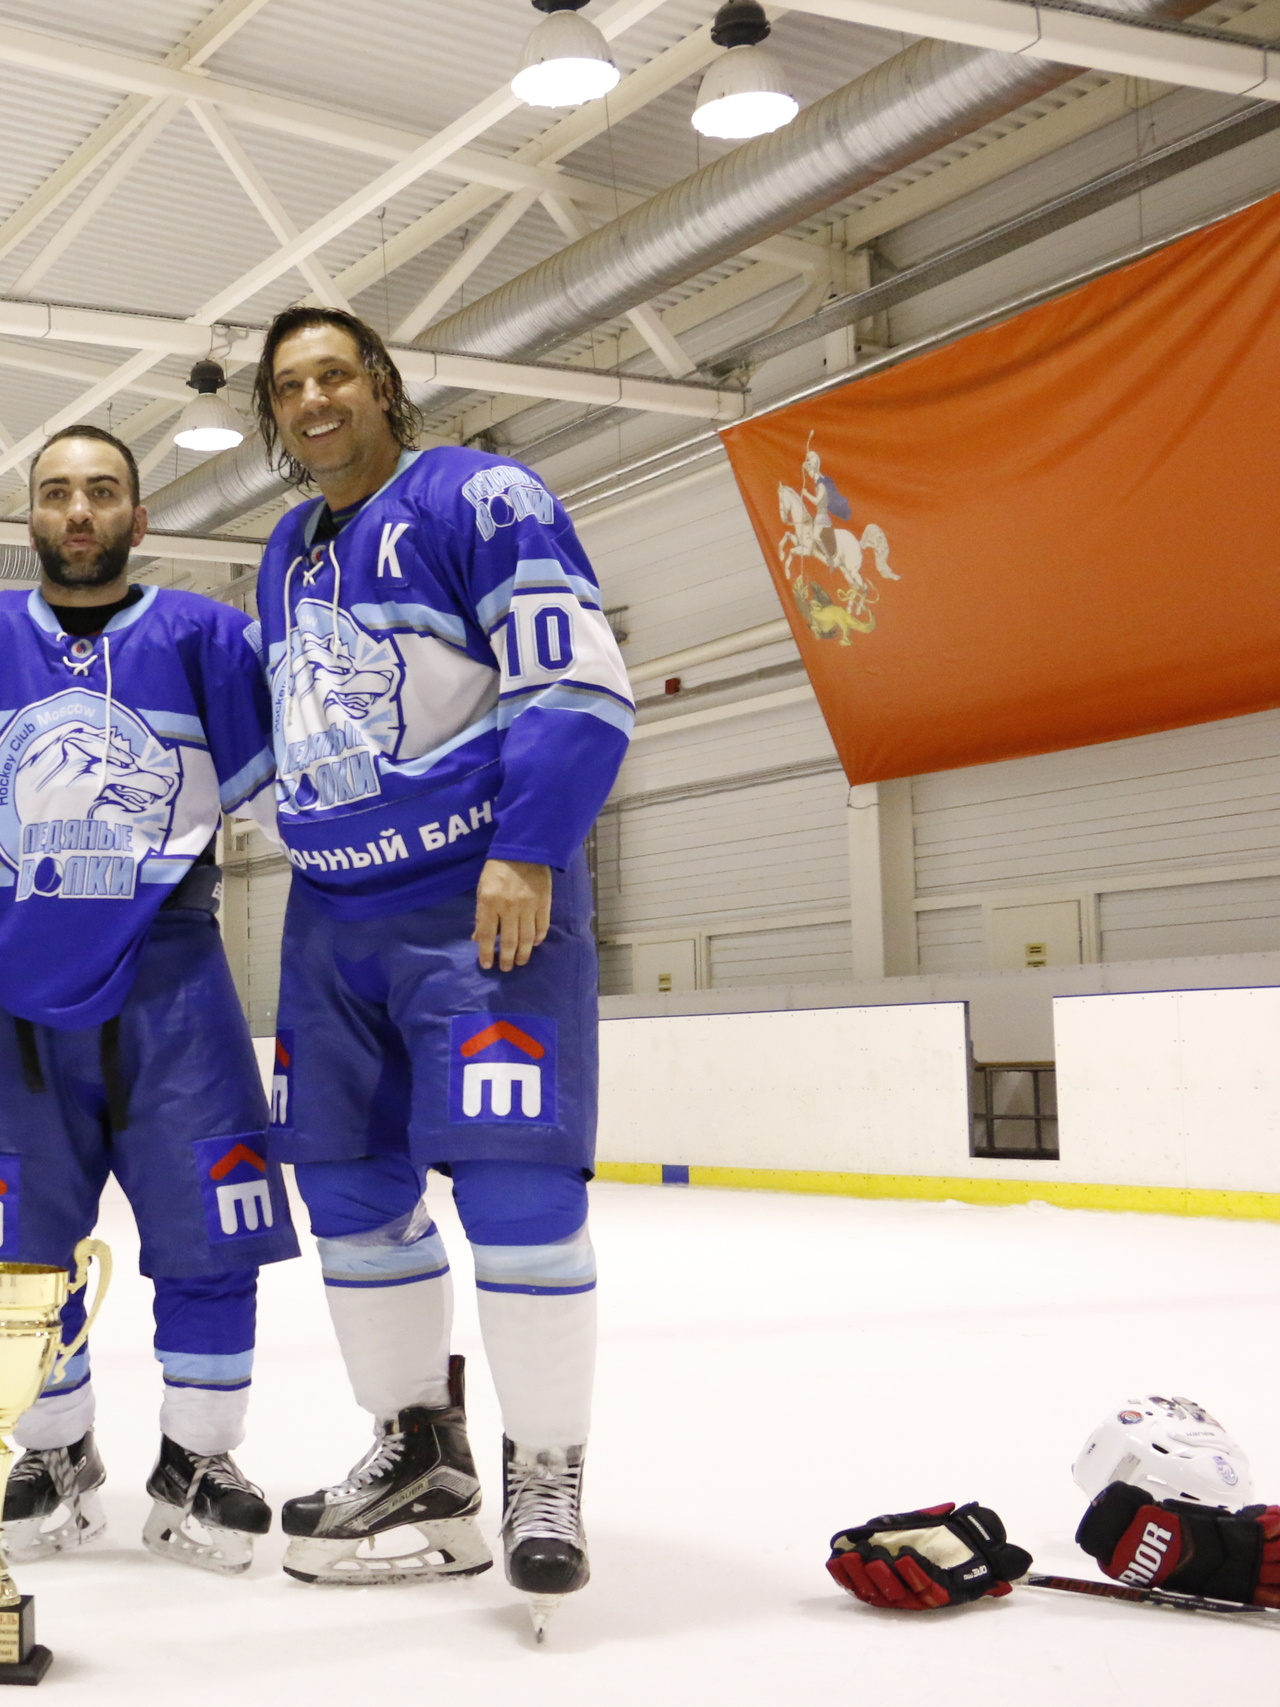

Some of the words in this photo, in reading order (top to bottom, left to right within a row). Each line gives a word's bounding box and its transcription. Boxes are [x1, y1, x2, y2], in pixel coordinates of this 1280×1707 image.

[505, 604, 578, 681] 10
[10, 722, 36, 752] Club
[36, 703, 96, 727] Moscow
[22, 819, 134, 854] ЛЕДЯНЫЕ
[285, 828, 410, 872] ОЧНЫЙ
[418, 797, 498, 851] БАН
[19, 855, 136, 899] ВОЛКИ
